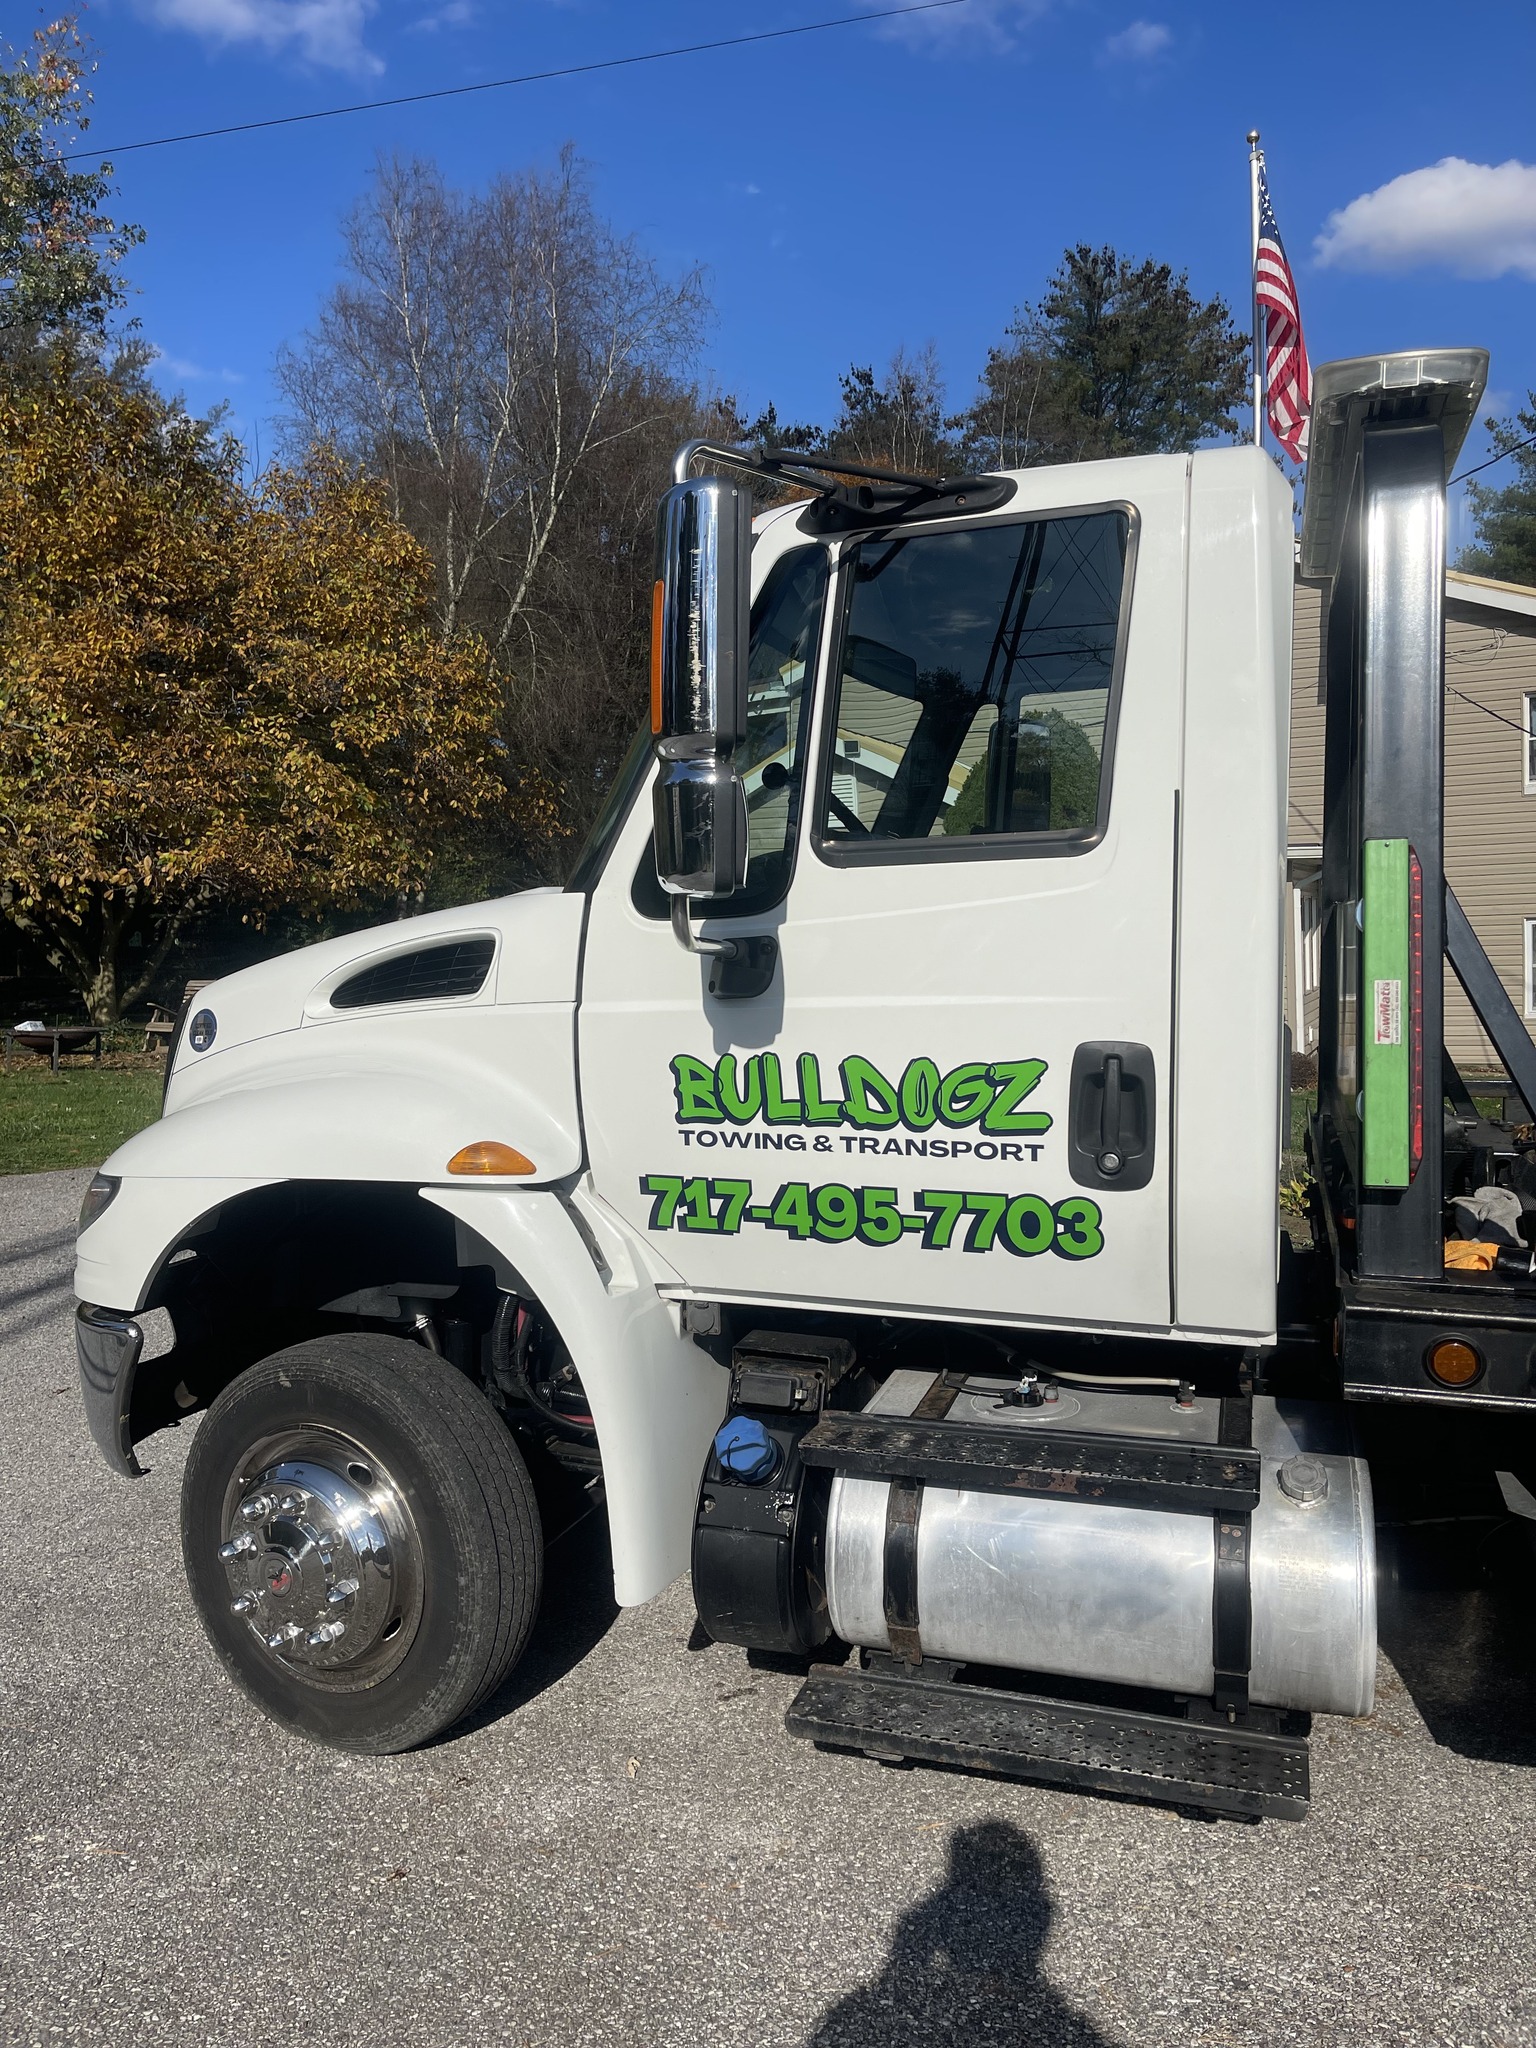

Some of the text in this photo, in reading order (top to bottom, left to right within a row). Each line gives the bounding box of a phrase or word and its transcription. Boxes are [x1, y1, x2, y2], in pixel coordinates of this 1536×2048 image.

[669, 1051, 1053, 1136] BULLDOGZ
[679, 1130, 1045, 1161] TOWING & TRANSPORT
[639, 1175, 1105, 1260] 717-495-7703
